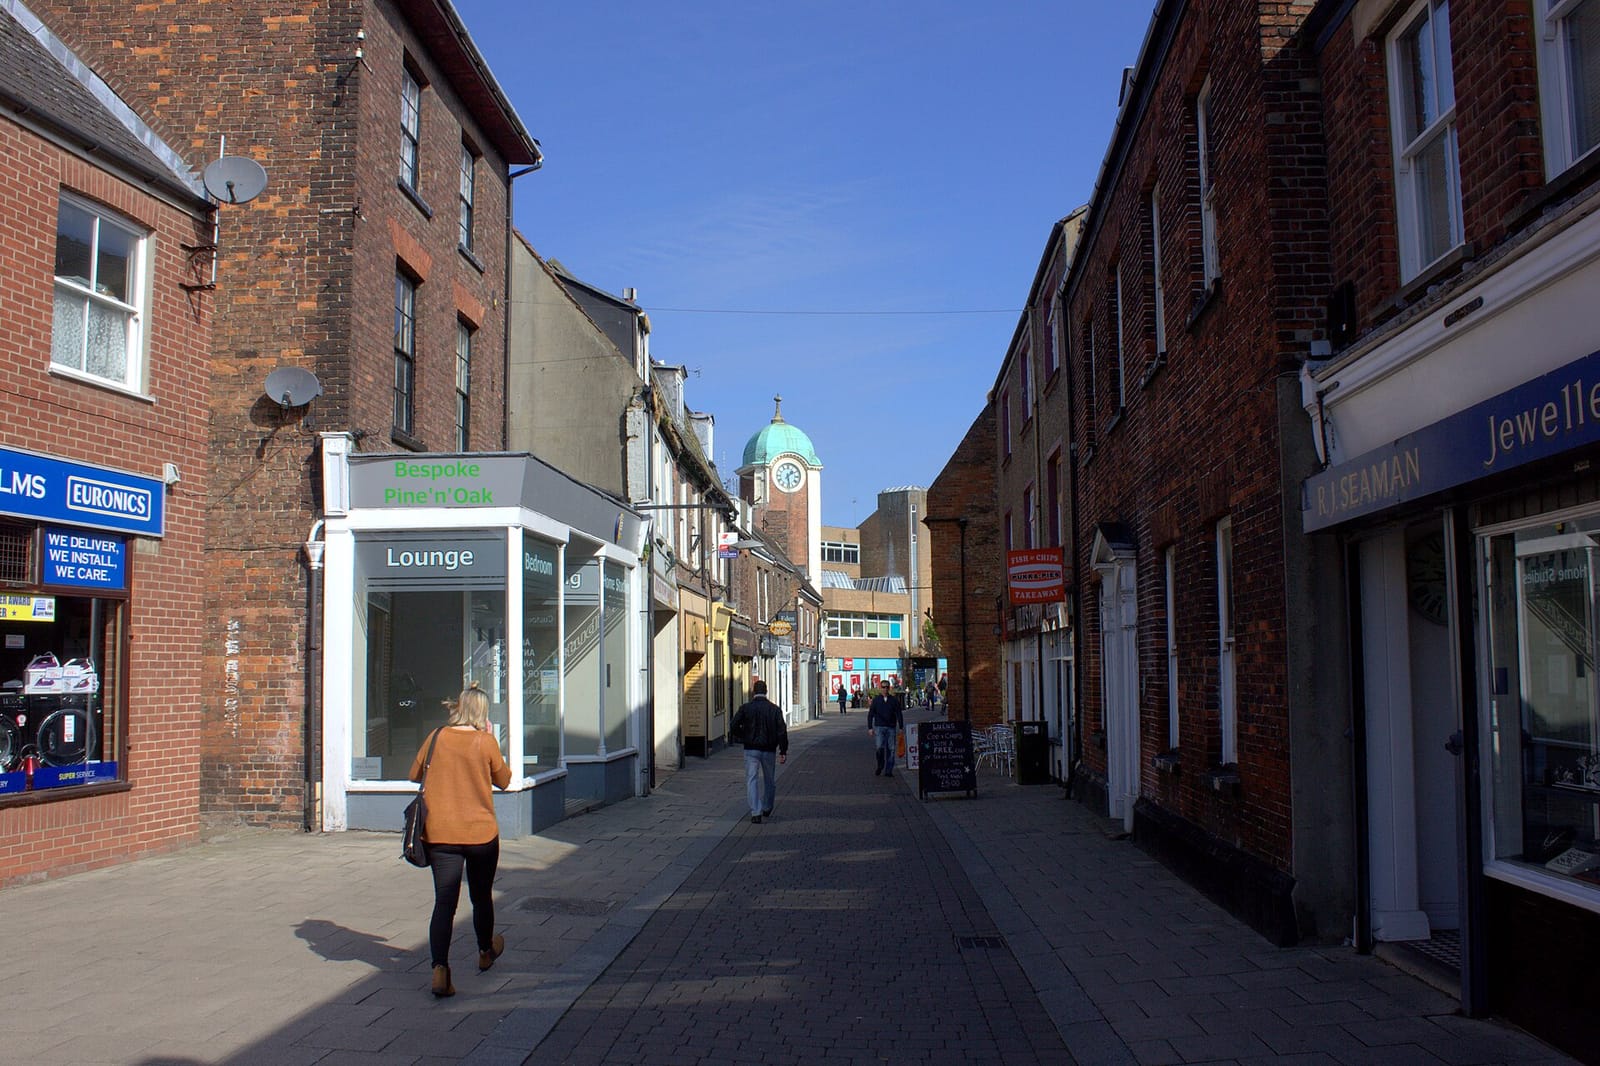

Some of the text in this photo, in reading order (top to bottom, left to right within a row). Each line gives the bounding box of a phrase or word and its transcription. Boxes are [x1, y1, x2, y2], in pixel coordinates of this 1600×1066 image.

[1484, 378, 1600, 467] Jewelle
[394, 461, 480, 480] Bespoke
[1340, 447, 1420, 508] SEAMAN
[73, 483, 146, 514] EURONICS
[384, 487, 493, 504] Pine'n'Oak
[48, 533, 119, 555] WE DELIVER,
[49, 549, 117, 569] WE INSTALL,
[387, 548, 474, 570] Lounge
[525, 552, 553, 576] Bedroom
[1010, 554, 1029, 564] FISH
[1036, 553, 1059, 562] CHIPS
[56, 565, 111, 581] WE CARE.
[8, 596, 31, 606] AWARD
[1015, 589, 1059, 599] TAKEAWAY
[933, 746, 954, 754] FREE
[58, 770, 96, 781] SUPER SERVICE
